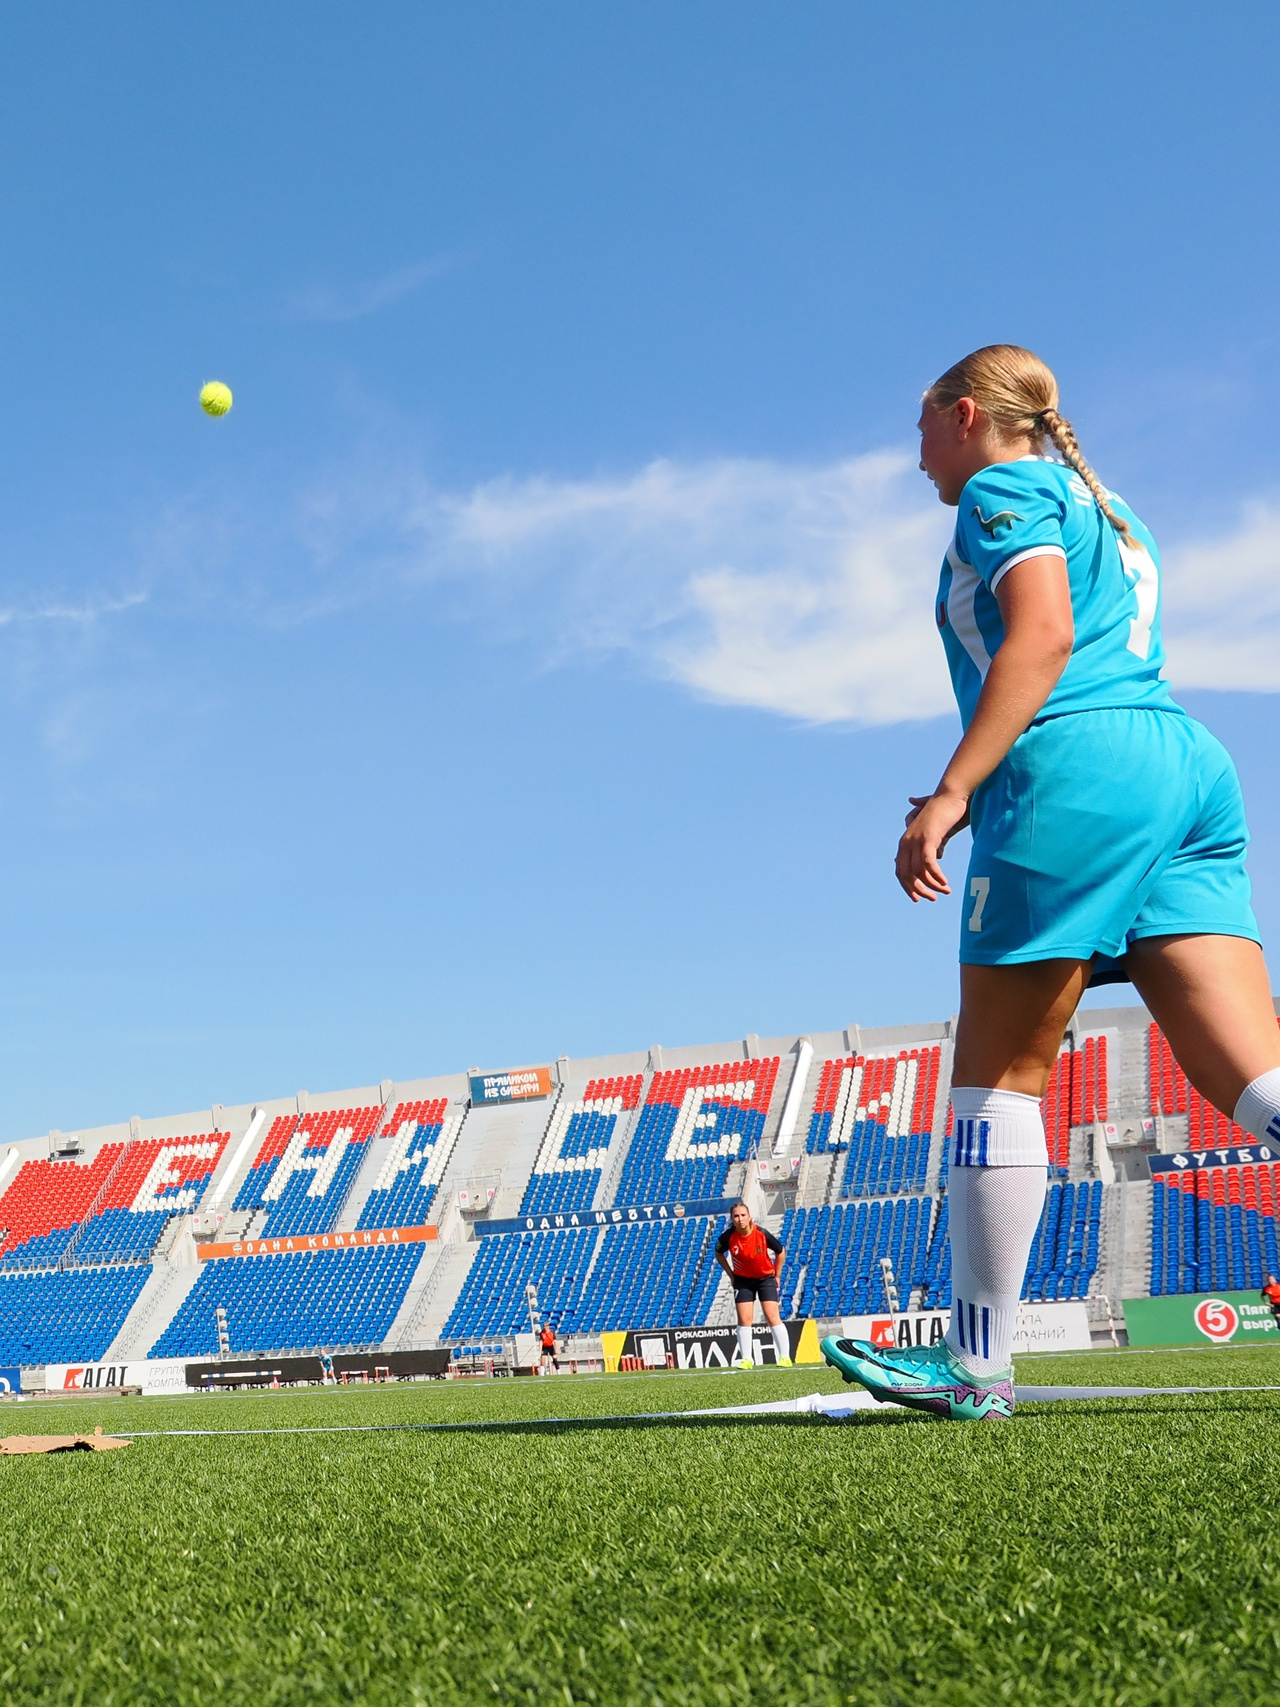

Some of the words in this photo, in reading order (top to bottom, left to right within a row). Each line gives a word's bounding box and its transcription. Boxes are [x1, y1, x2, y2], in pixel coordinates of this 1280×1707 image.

[1116, 539, 1159, 662] 7
[968, 877, 990, 932] 7
[484, 1072, 538, 1088] ПРЯМИКОМ
[484, 1087, 499, 1098] ИЗ
[500, 1083, 539, 1096] СИБИРИ
[1172, 1145, 1271, 1169] ФУТБО
[526, 1214, 579, 1229] ОДНА
[247, 1238, 294, 1253] ОДНА
[308, 1229, 399, 1248] КОМАНДА
[1239, 1304, 1271, 1316] Пят
[675, 1329, 730, 1342] рекламная
[898, 1316, 951, 1348] АГА
[83, 1366, 128, 1388] АГАТ
[150, 1366, 185, 1376] ГРУППА
[148, 1377, 186, 1389] КОМПАН
